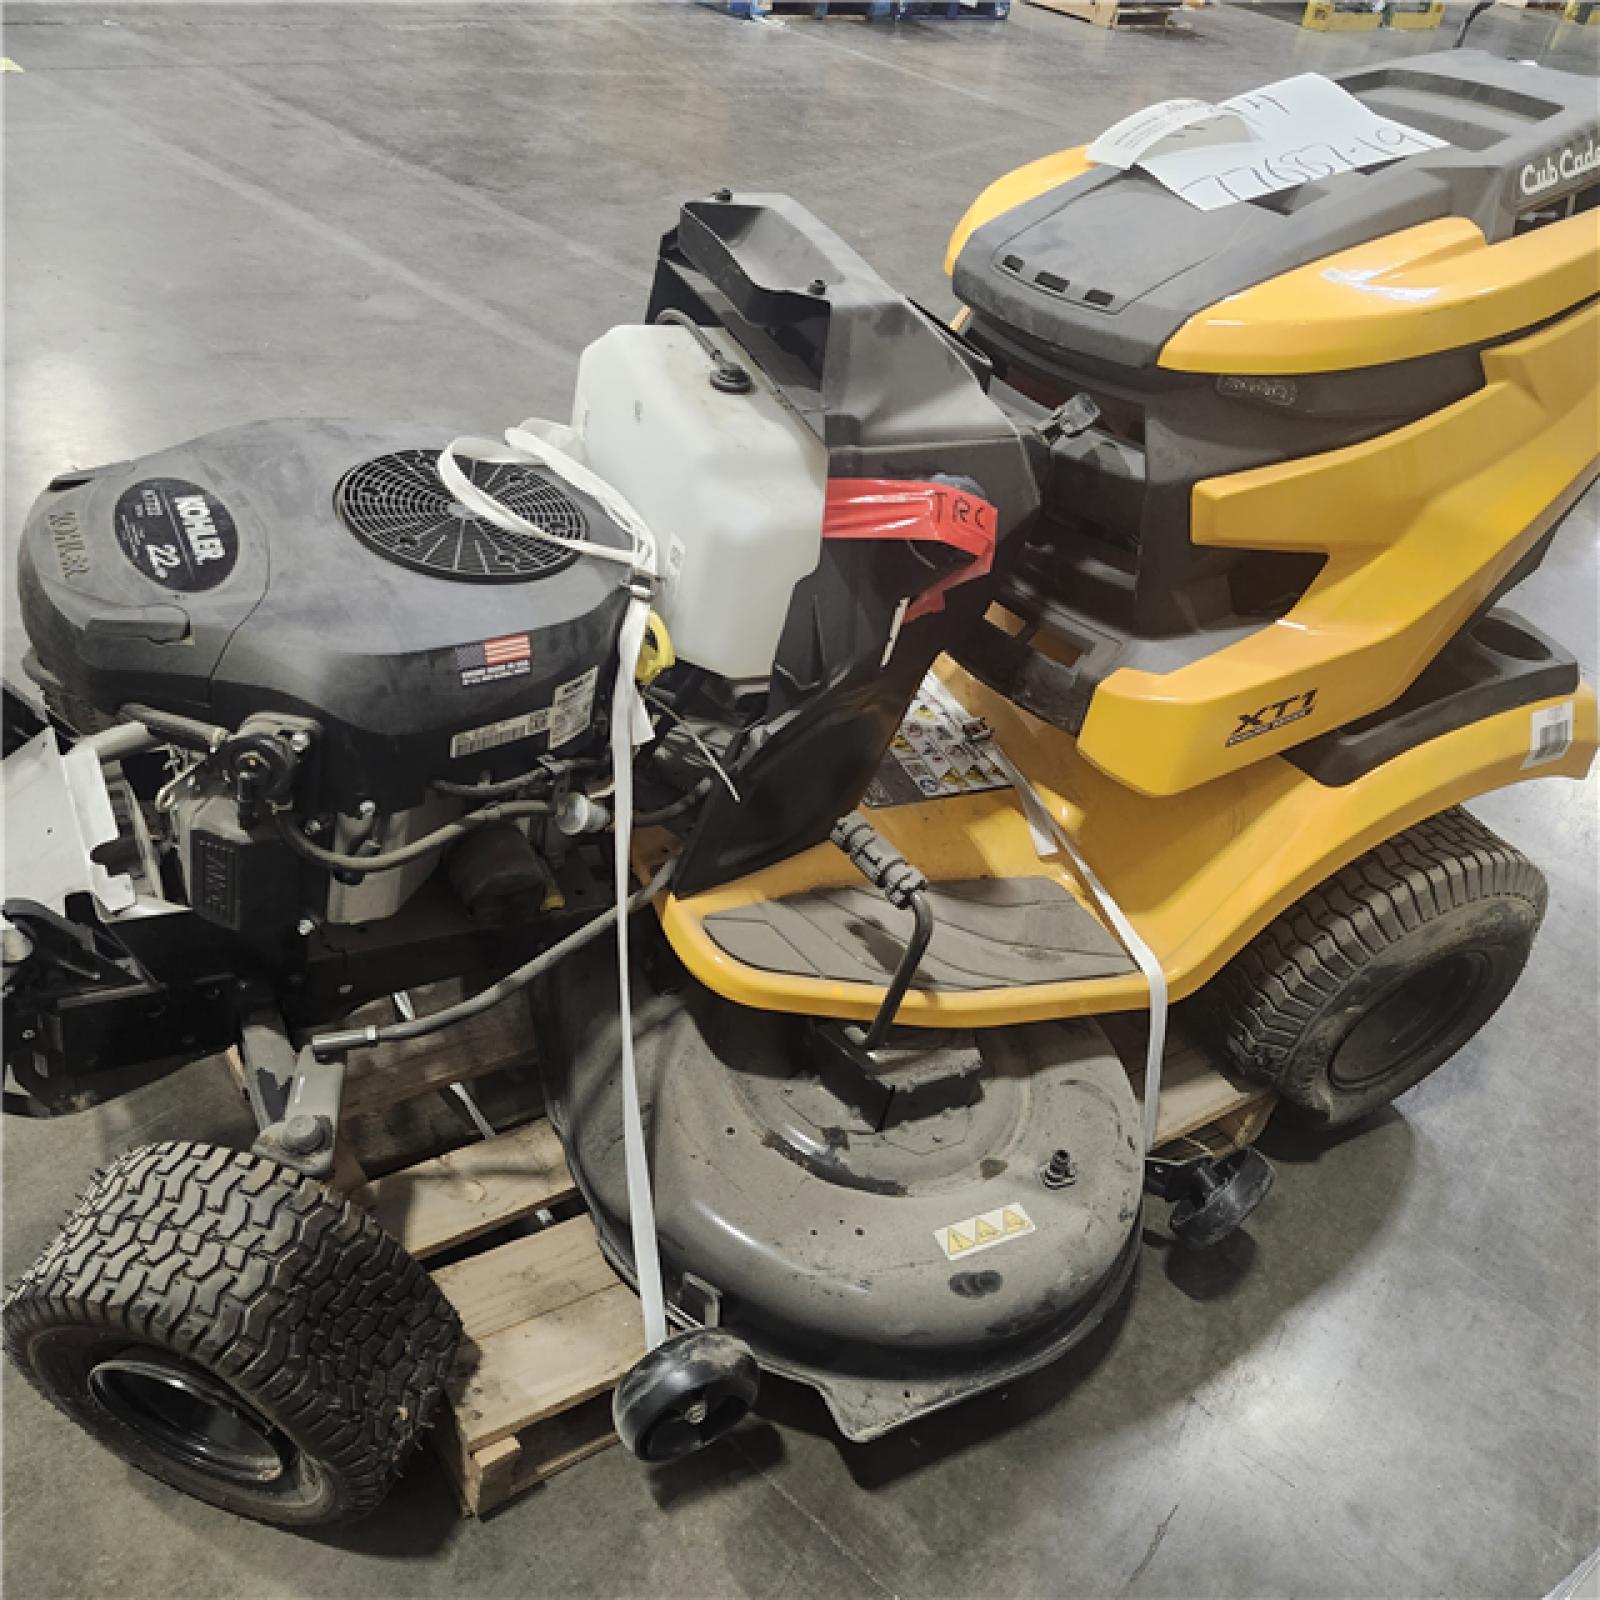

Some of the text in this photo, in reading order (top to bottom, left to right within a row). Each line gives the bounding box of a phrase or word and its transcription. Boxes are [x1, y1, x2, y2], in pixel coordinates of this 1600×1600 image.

[1520, 156, 1558, 196] Cub
[174, 495, 225, 566] KOHLER
[934, 492, 985, 530] TRC
[1233, 687, 1318, 733] XT1
